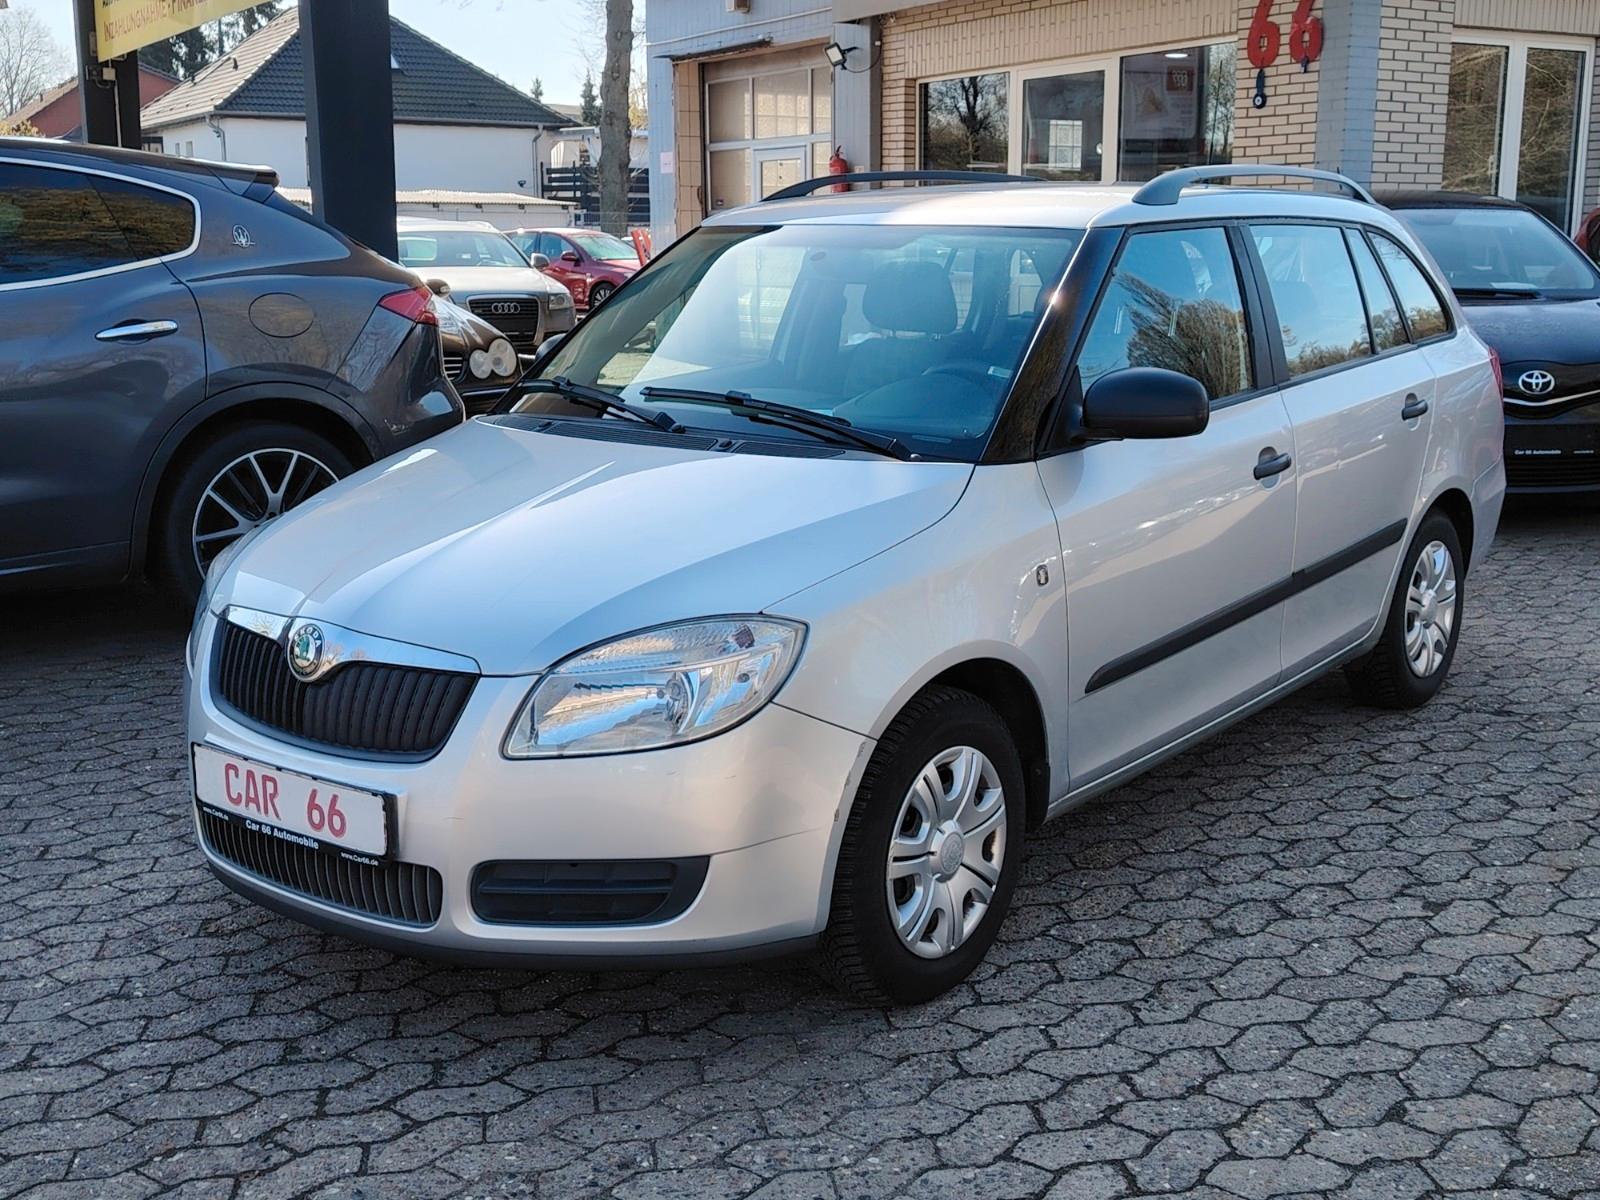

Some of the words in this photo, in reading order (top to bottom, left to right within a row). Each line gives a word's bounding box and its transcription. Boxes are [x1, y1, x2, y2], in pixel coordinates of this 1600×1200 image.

[1246, 0, 1325, 69] 66
[224, 762, 282, 822] CAR
[306, 788, 347, 839] 66
[245, 819, 260, 832] Car
[261, 824, 272, 836] 66
[273, 827, 319, 850] Automobile
[340, 851, 379, 867] www.Car66.de
